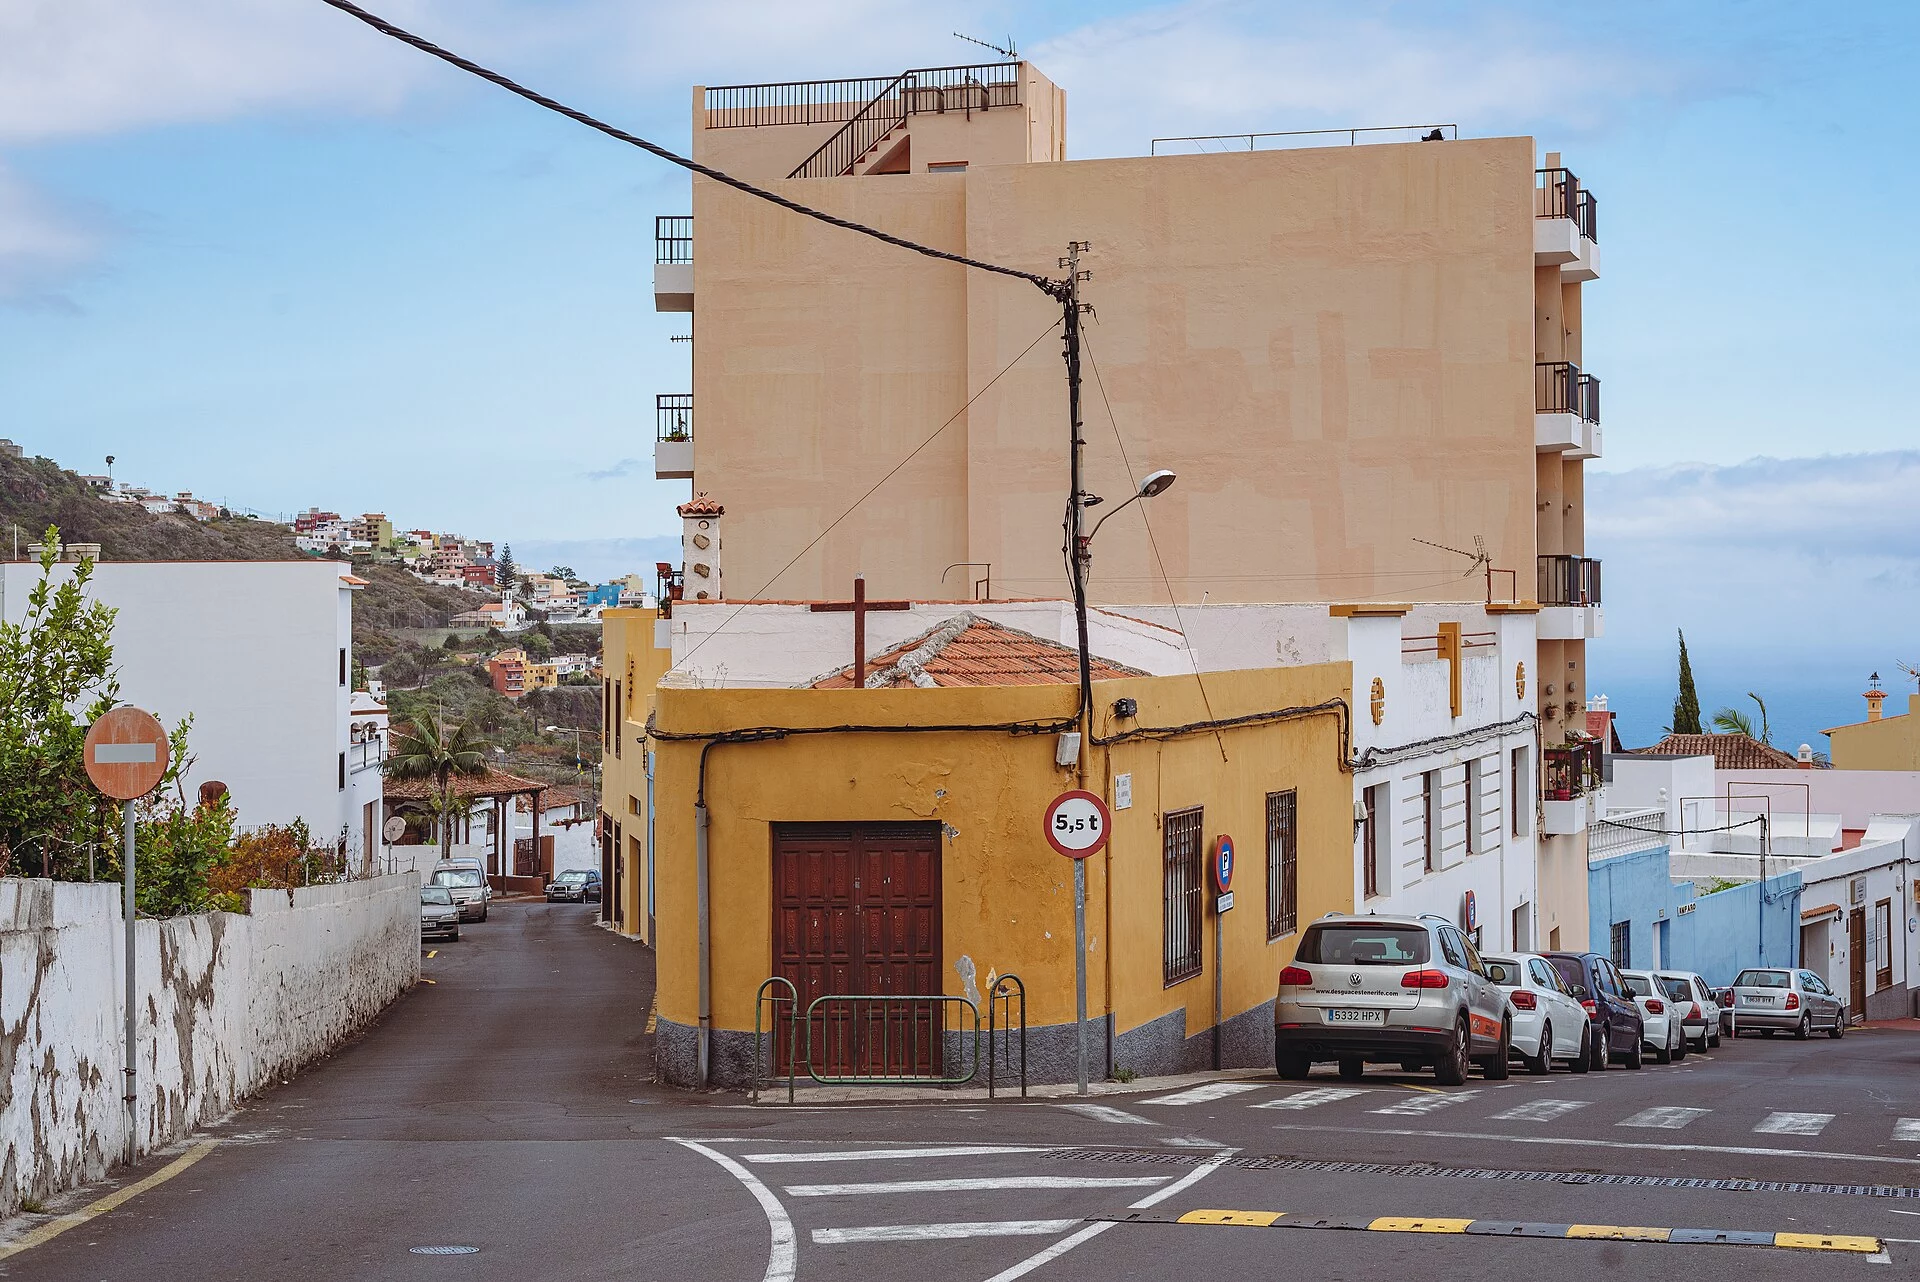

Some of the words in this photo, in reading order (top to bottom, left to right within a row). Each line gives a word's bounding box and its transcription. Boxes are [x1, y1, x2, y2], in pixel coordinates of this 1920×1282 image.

[1055, 814, 1084, 833] 5,5
[1089, 815, 1097, 830] t
[1223, 853, 1228, 868] P
[1315, 988, 1398, 996] www.desguacestenerife.com
[1334, 1011, 1358, 1020] 5332
[1362, 1012, 1380, 1020] HPX
